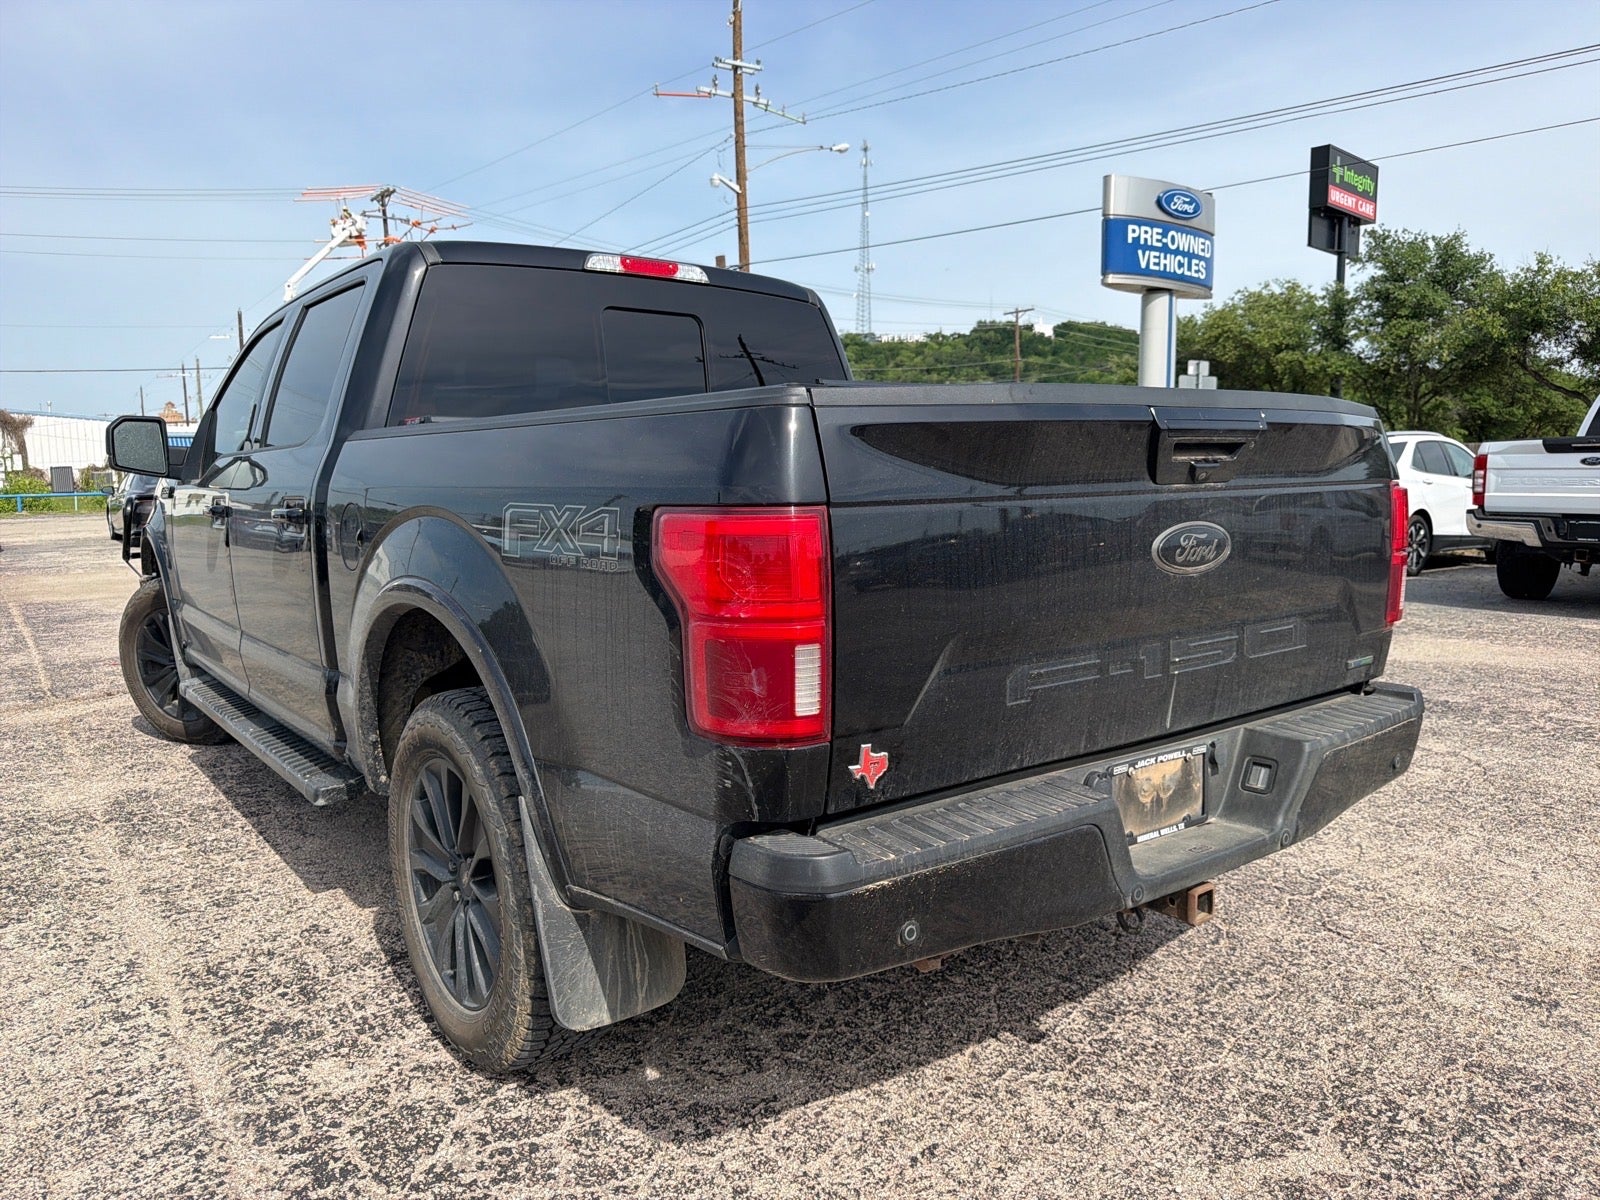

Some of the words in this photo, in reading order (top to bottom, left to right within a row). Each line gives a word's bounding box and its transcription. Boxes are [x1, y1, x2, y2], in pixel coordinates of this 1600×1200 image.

[1344, 165, 1375, 196] Integrity
[1170, 195, 1196, 213] Ford
[1330, 189, 1356, 209] URGENT
[1357, 200, 1375, 217] CARE
[1127, 224, 1211, 258] PRE-OWNED
[1137, 249, 1206, 279] VEHICLES
[502, 502, 620, 560] FX4
[550, 554, 576, 566] OFF
[580, 557, 618, 571] ROAD
[1175, 533, 1218, 563] Ford
[1006, 618, 1307, 706] F-150
[1135, 757, 1157, 769] JACK
[1157, 750, 1188, 763] POWELL
